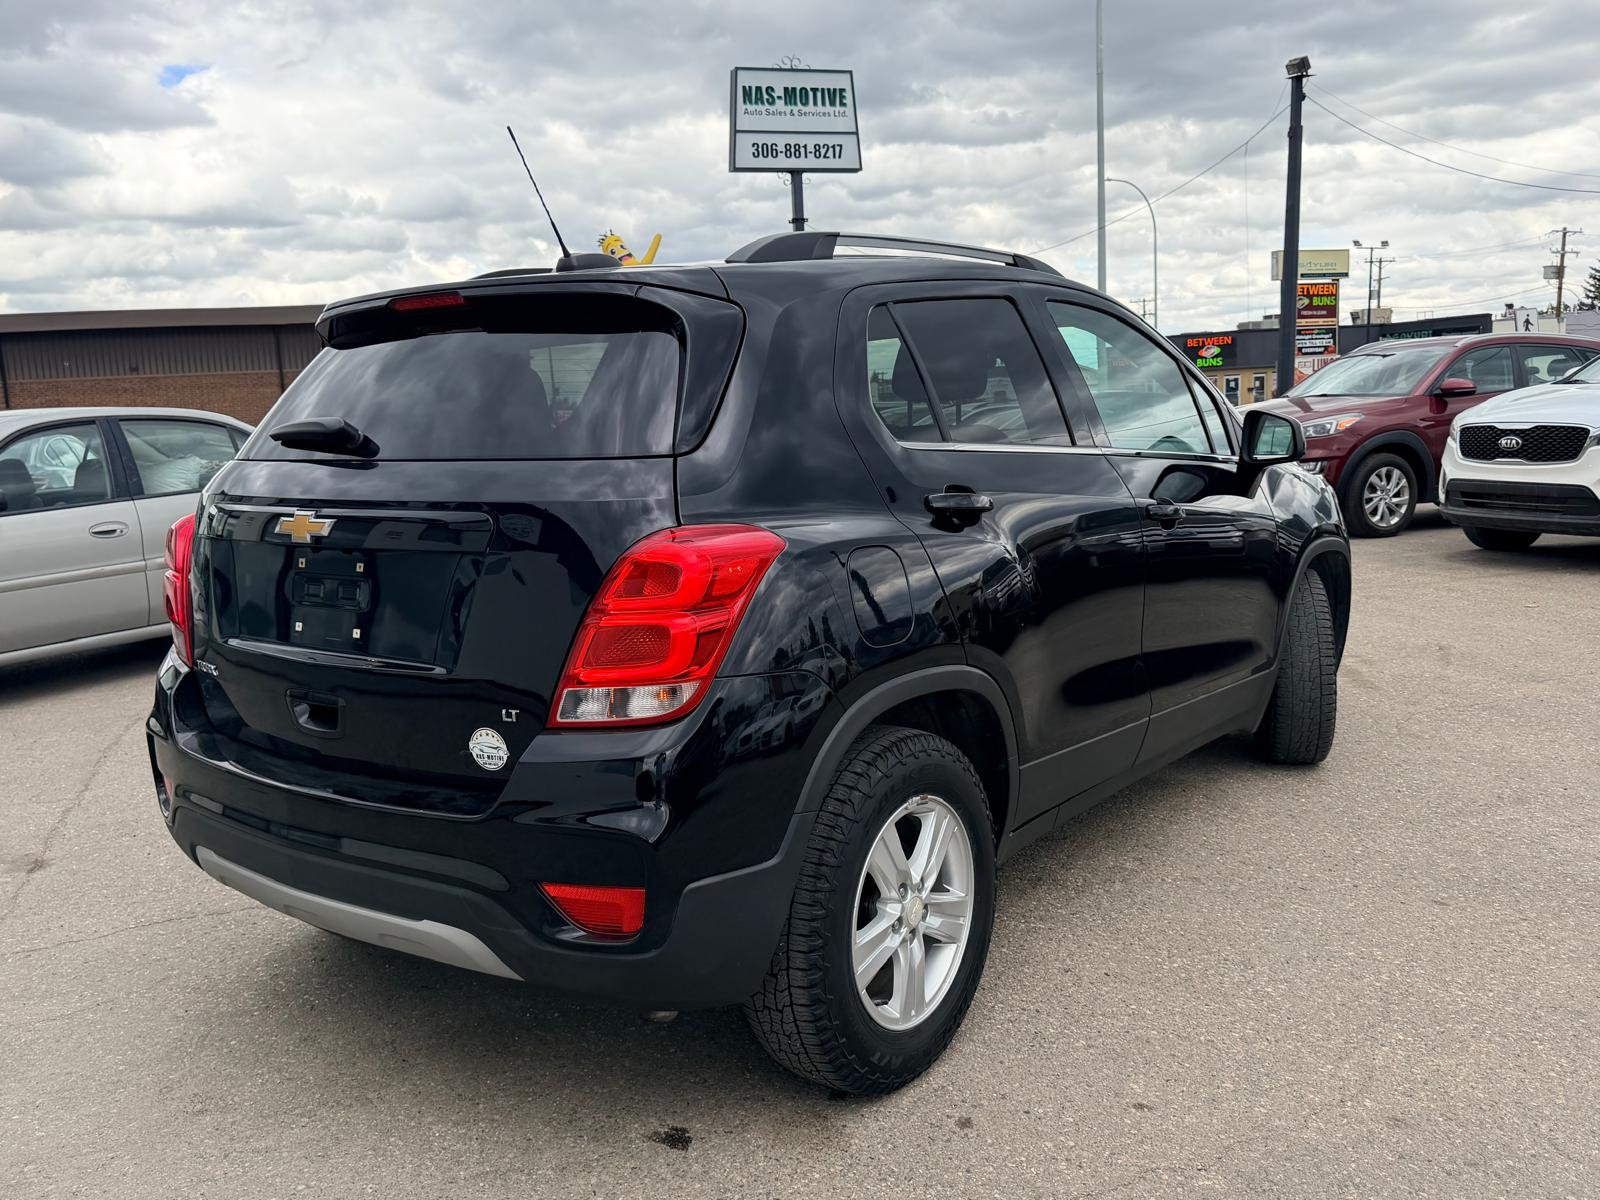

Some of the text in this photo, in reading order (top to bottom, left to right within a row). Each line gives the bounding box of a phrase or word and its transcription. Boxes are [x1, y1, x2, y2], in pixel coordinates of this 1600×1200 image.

[742, 85, 847, 107] NAS-MOTIVE
[743, 108, 848, 118] Auto Sales & Services Ltd.
[751, 142, 843, 159] 306-881-8217
[1297, 284, 1336, 295] ETWEEN
[1312, 296, 1336, 306] BUNS
[1187, 336, 1232, 347] BETWEEN
[1196, 357, 1223, 367] BUNS
[1501, 440, 1517, 448] KIA
[502, 709, 520, 722] LT
